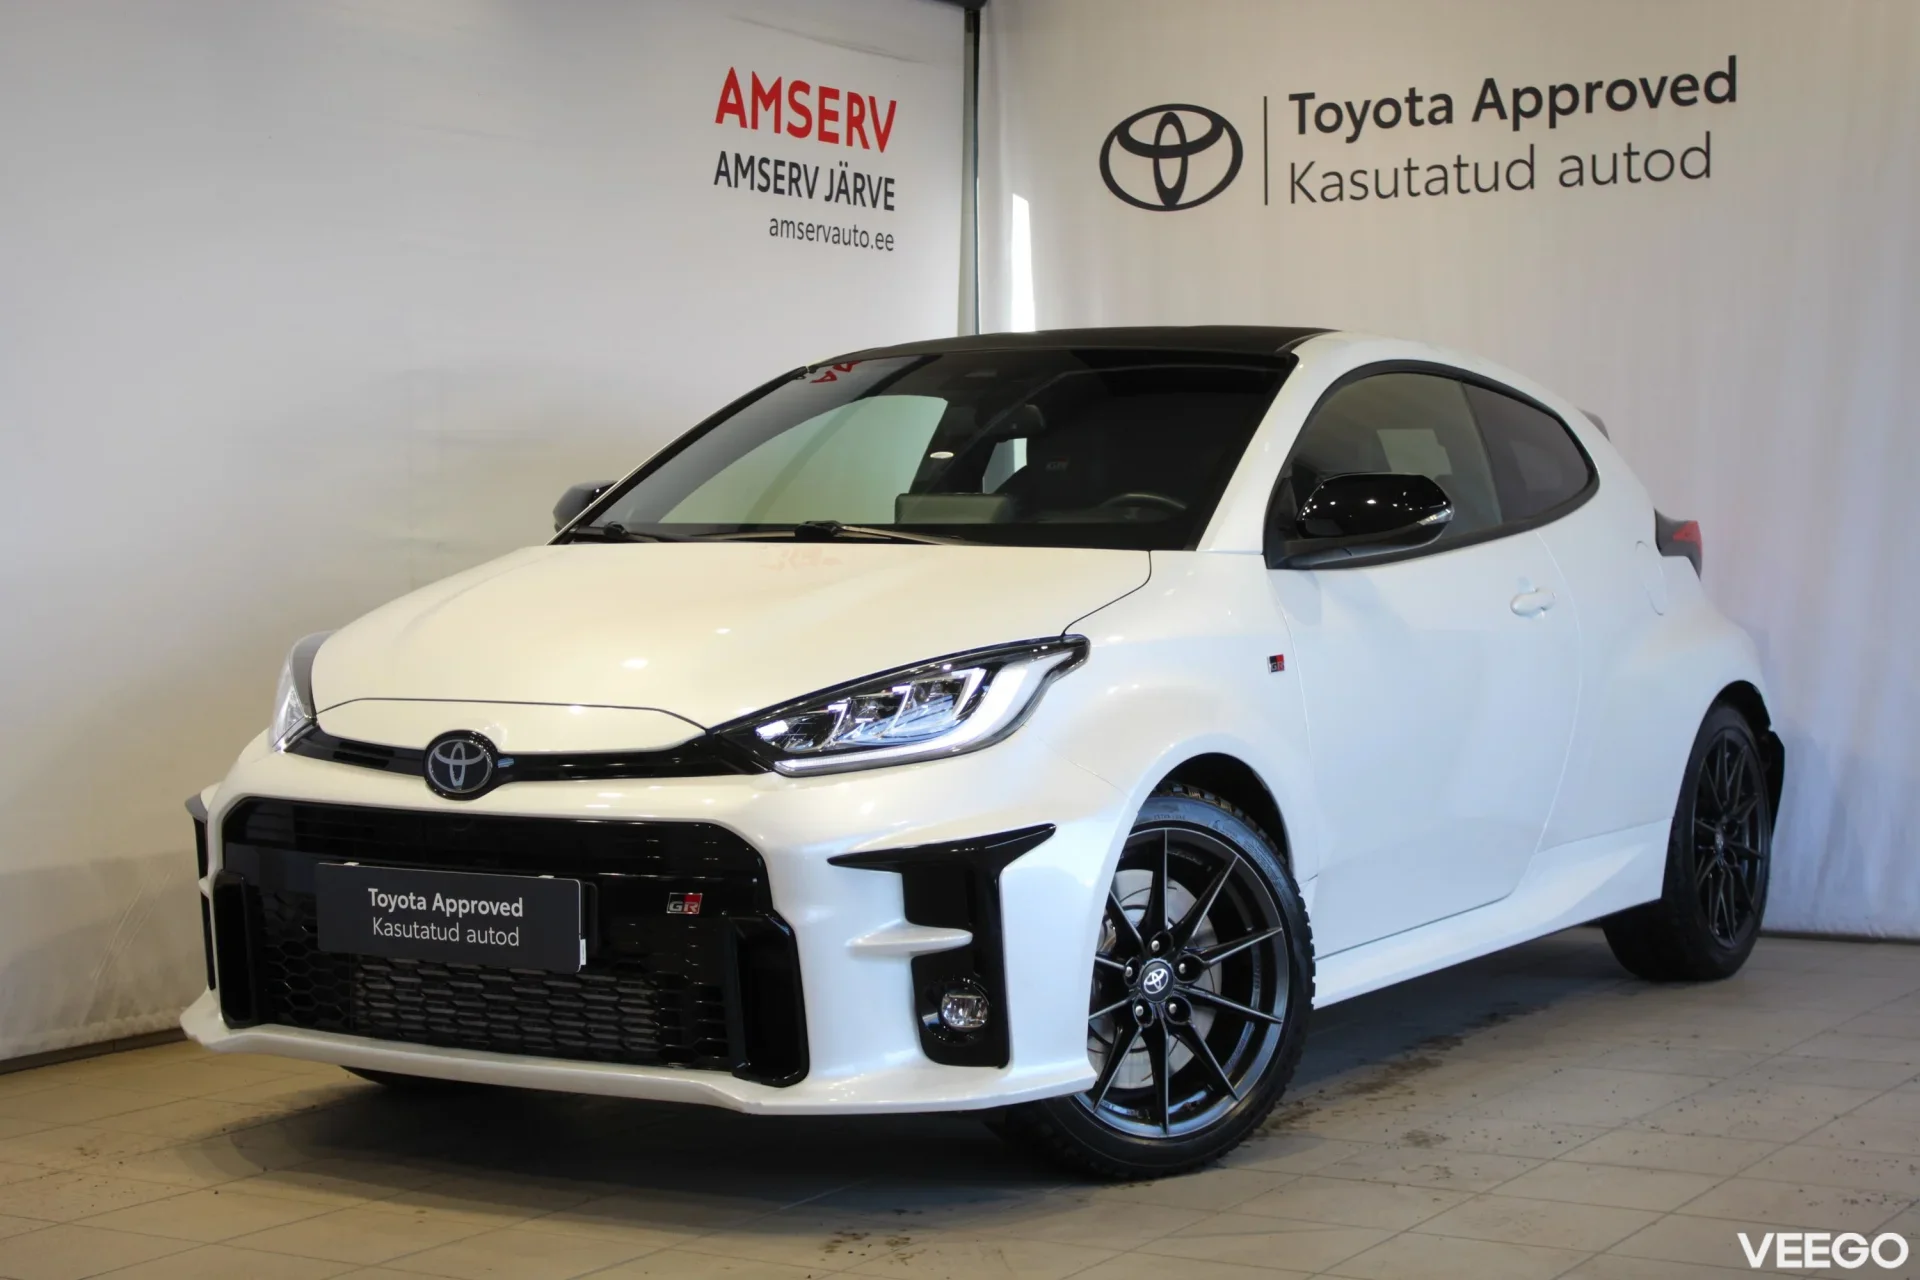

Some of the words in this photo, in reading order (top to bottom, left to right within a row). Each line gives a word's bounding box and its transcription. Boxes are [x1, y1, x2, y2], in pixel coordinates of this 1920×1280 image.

[715, 66, 897, 153] AMSERV
[1288, 87, 1453, 143] Toyota
[1471, 55, 1737, 132] Approved
[713, 150, 819, 200] AMSERV
[824, 160, 895, 211] JÄRVE
[1290, 143, 1535, 204] Kasutatud
[1558, 130, 1711, 188] autod
[769, 217, 894, 251] amservauto.ee
[367, 888, 427, 913] Toyota
[431, 892, 523, 918] Approved
[669, 900, 699, 912] GR
[373, 916, 460, 942] Kasutatud
[466, 926, 519, 946] autod
